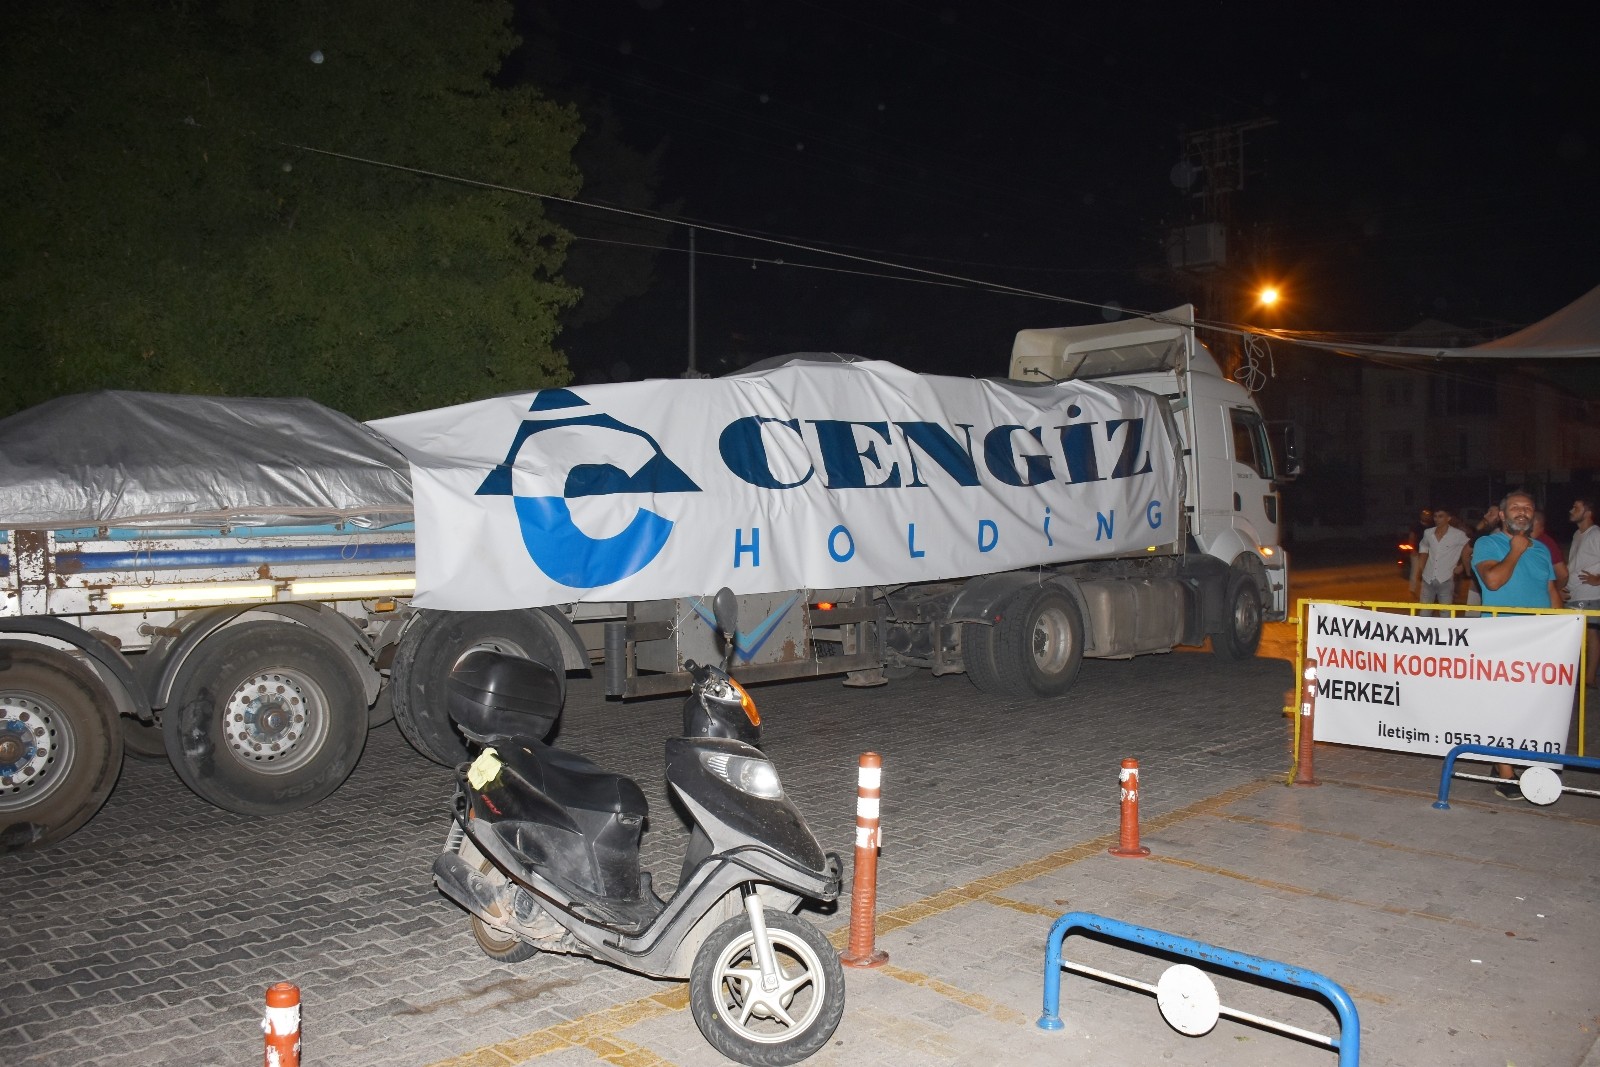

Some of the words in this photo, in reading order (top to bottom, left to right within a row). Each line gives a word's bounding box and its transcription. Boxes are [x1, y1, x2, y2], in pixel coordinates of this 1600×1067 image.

[719, 404, 1153, 489] CENGİZ
[1316, 614, 1469, 647] KAYMAKAMLIK
[1316, 647, 1387, 673] YANGIN
[1394, 653, 1574, 686] KOORDİNASYON
[1317, 679, 1400, 706] MERKEZİ
[1378, 721, 1430, 743] İletişim
[1444, 732, 1480, 746] 0553
[1487, 736, 1514, 749] 243
[1520, 739, 1538, 752] 43
[1543, 742, 1561, 755] 03
